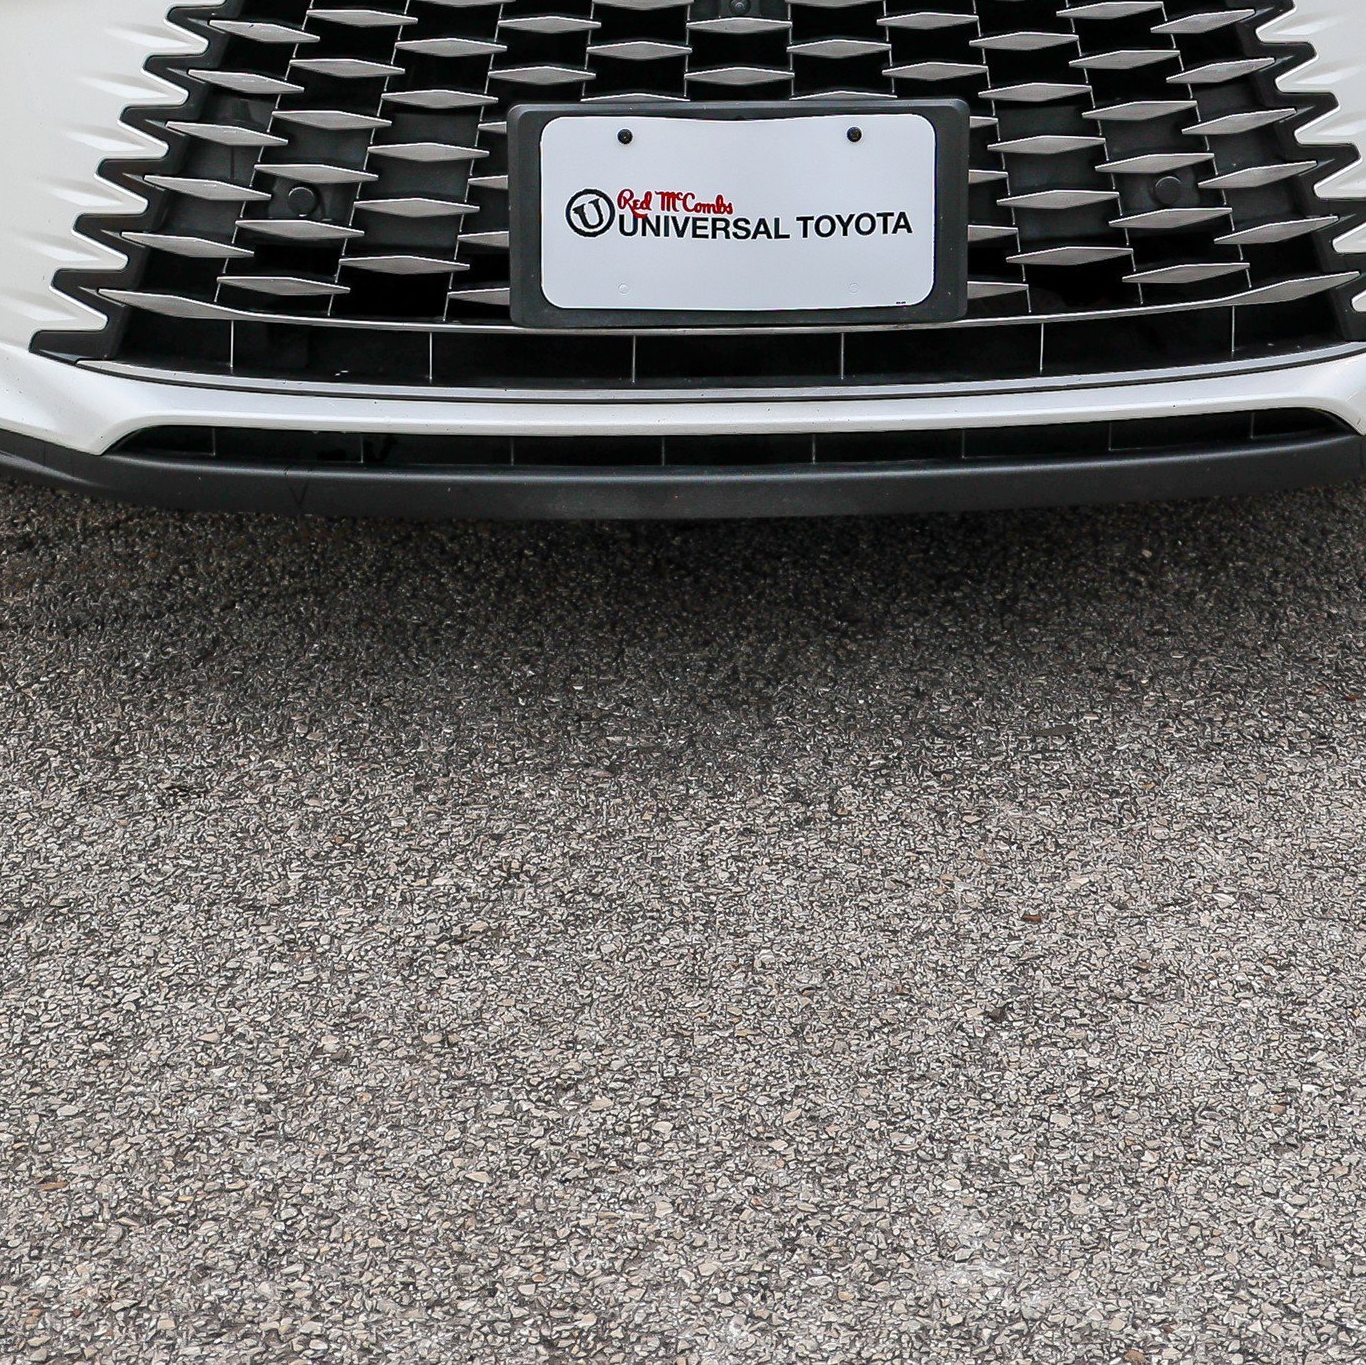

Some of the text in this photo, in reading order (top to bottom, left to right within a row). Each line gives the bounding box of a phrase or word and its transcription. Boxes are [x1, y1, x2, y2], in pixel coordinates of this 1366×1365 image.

[617, 188, 733, 218] Red McCombs
[618, 211, 913, 240] UNIVERSAL TOYOTA
